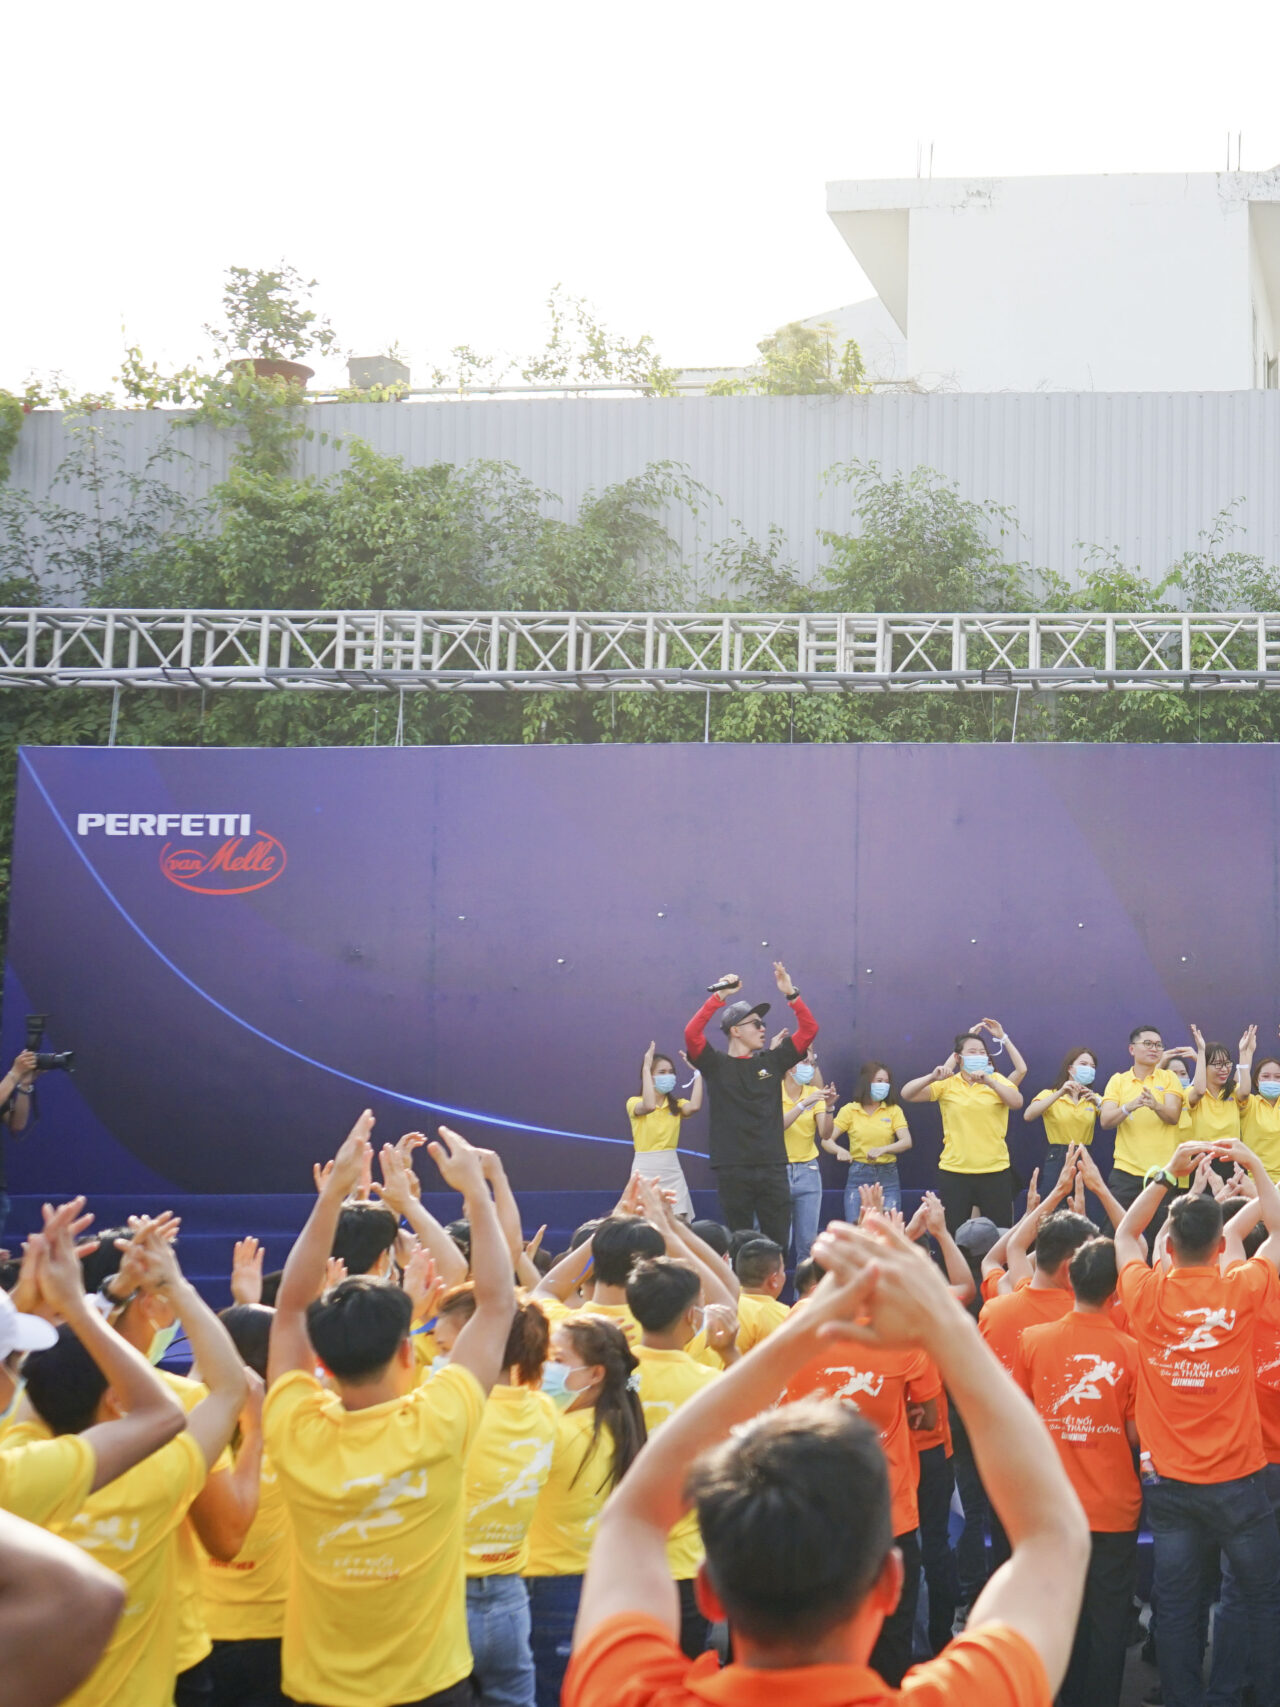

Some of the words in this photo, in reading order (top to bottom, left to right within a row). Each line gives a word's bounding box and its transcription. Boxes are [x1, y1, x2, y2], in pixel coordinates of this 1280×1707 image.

[77, 813, 251, 836] PERFETTI
[167, 857, 203, 871] van
[208, 837, 276, 873] Melle
